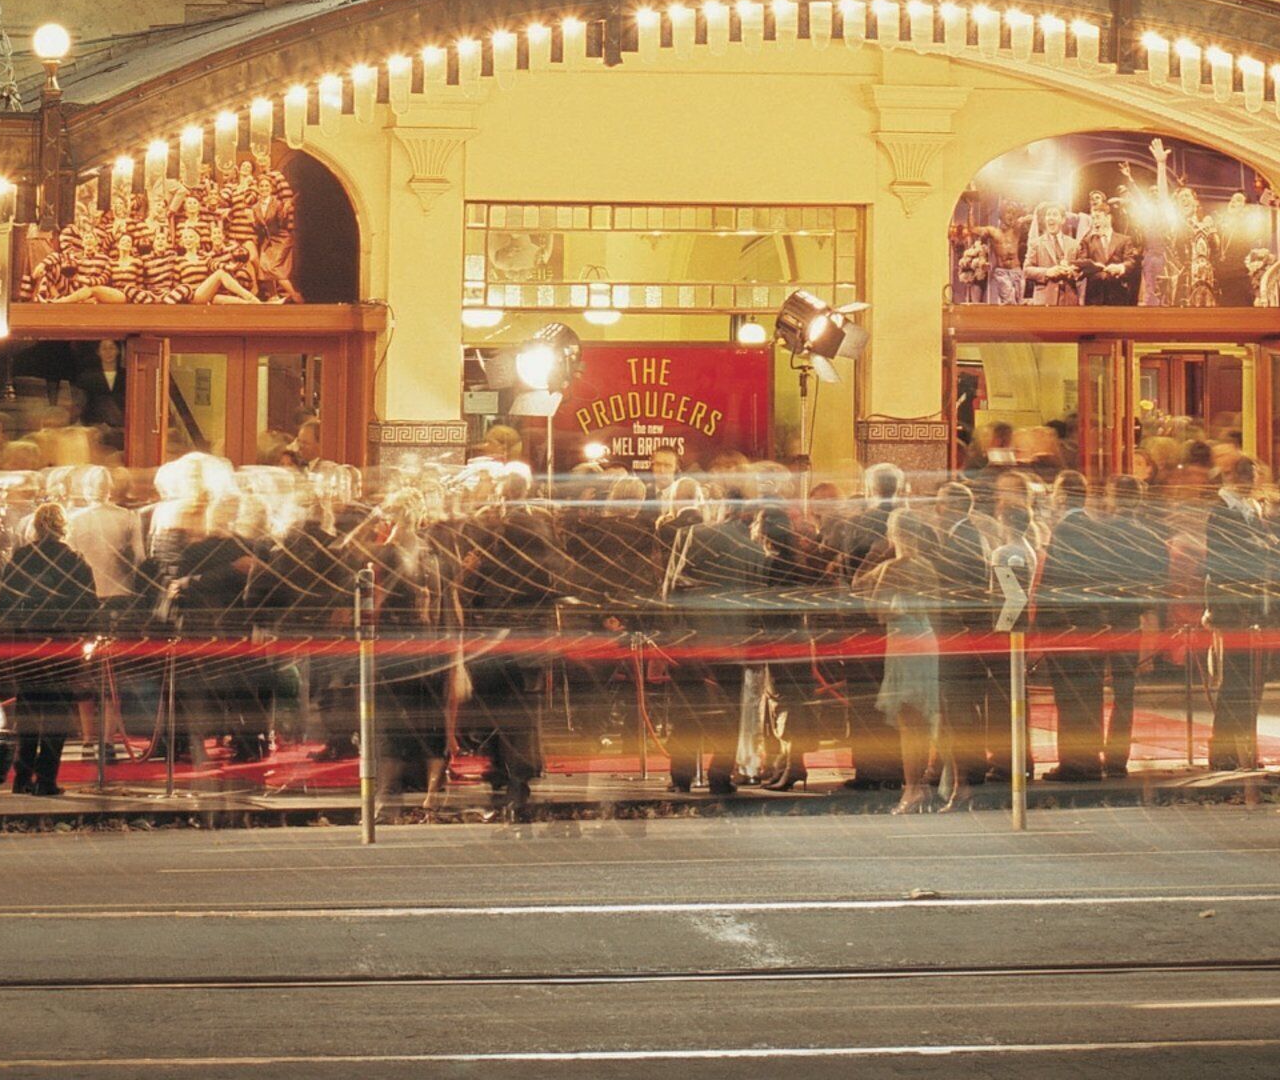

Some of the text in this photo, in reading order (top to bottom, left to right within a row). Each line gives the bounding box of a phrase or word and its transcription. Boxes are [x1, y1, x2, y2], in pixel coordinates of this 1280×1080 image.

[627, 357, 672, 386] THE
[576, 391, 723, 437] PRODUCERS
[632, 421, 665, 435] the new
[612, 437, 635, 456] MEL
[632, 458, 652, 470] musi
